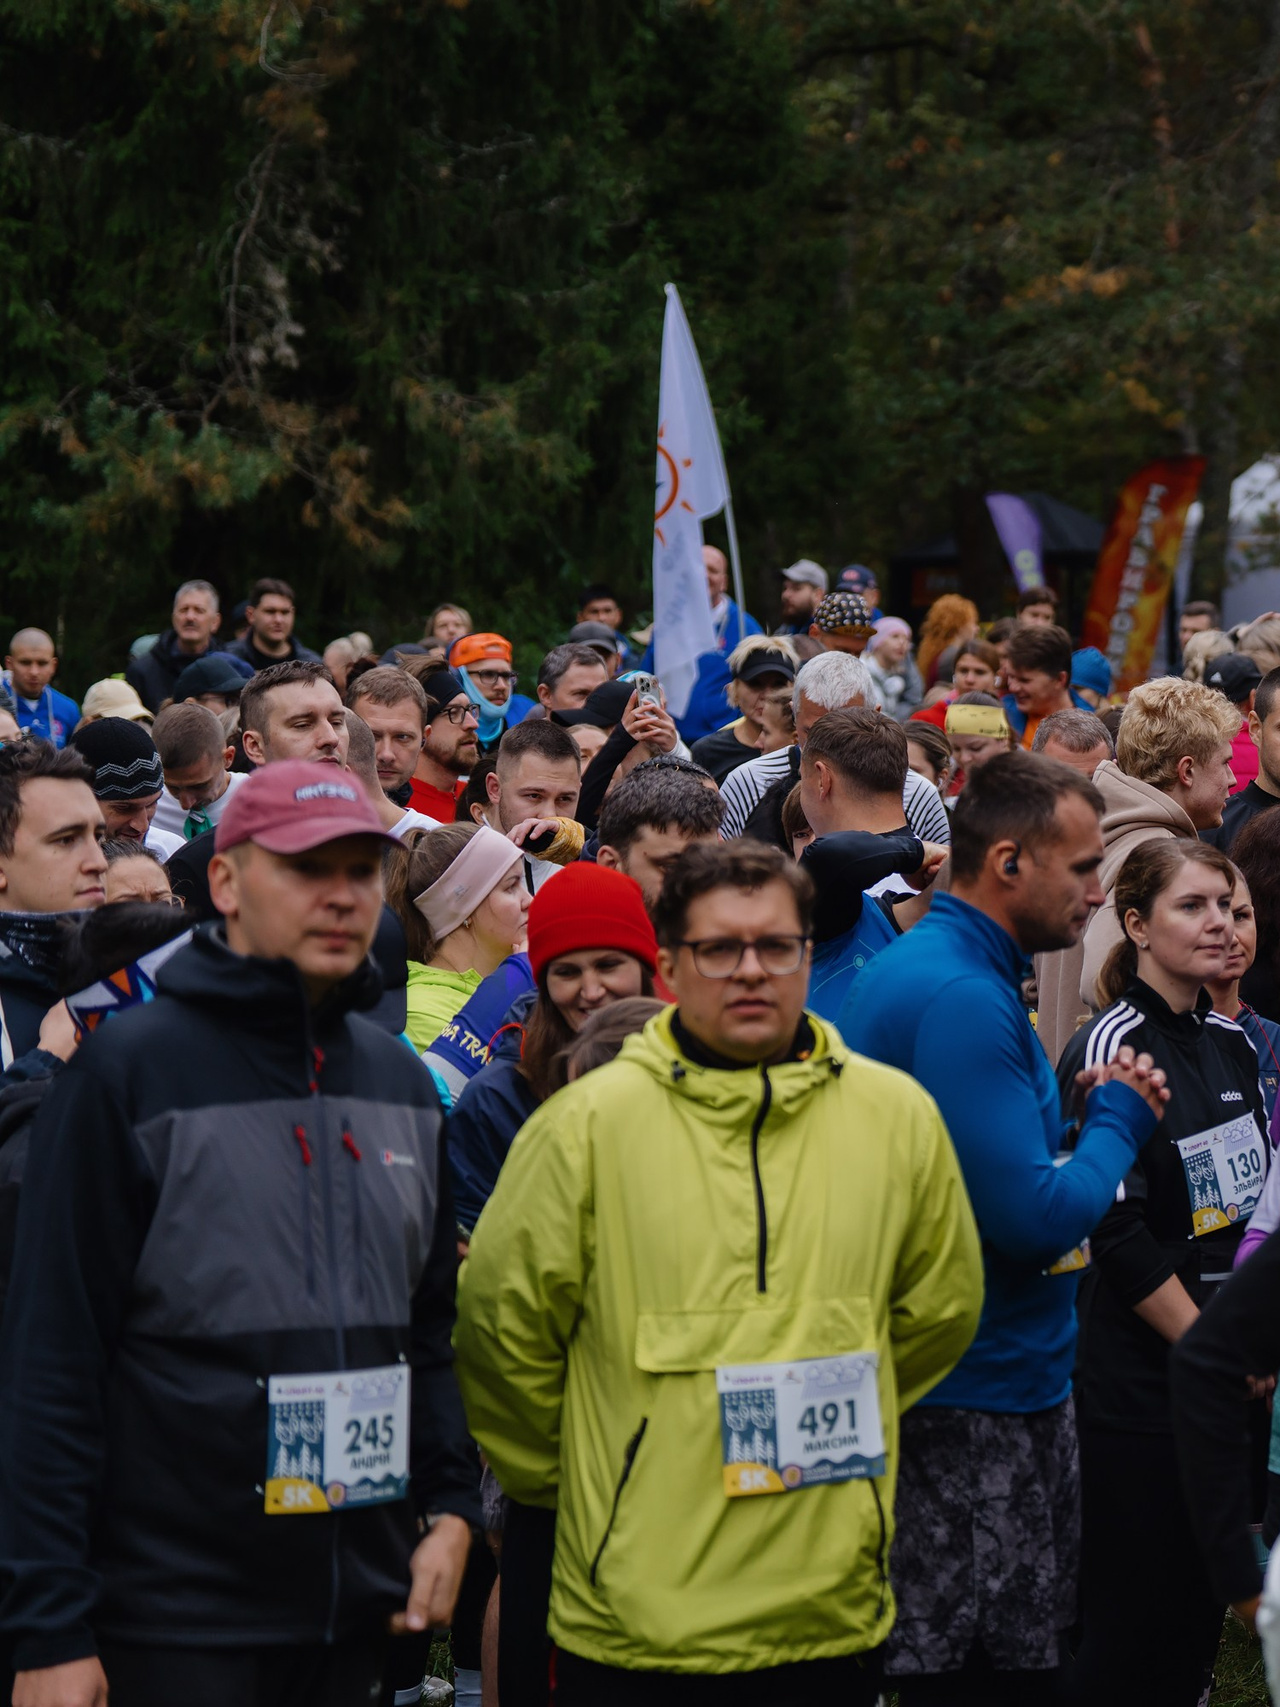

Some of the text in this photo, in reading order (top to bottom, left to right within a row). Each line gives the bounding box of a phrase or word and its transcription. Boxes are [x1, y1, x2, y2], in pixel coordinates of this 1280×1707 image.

[1227, 1148, 1261, 1182] 130
[1233, 1175, 1263, 1195] ЭЛЬВИРА
[1202, 1212, 1220, 1230] 5K
[797, 1398, 857, 1438] 491
[344, 1414, 394, 1455] 245
[803, 1433, 859, 1454] МАКСИМ
[739, 1469, 770, 1491] 5K
[282, 1486, 313, 1508] 5K
